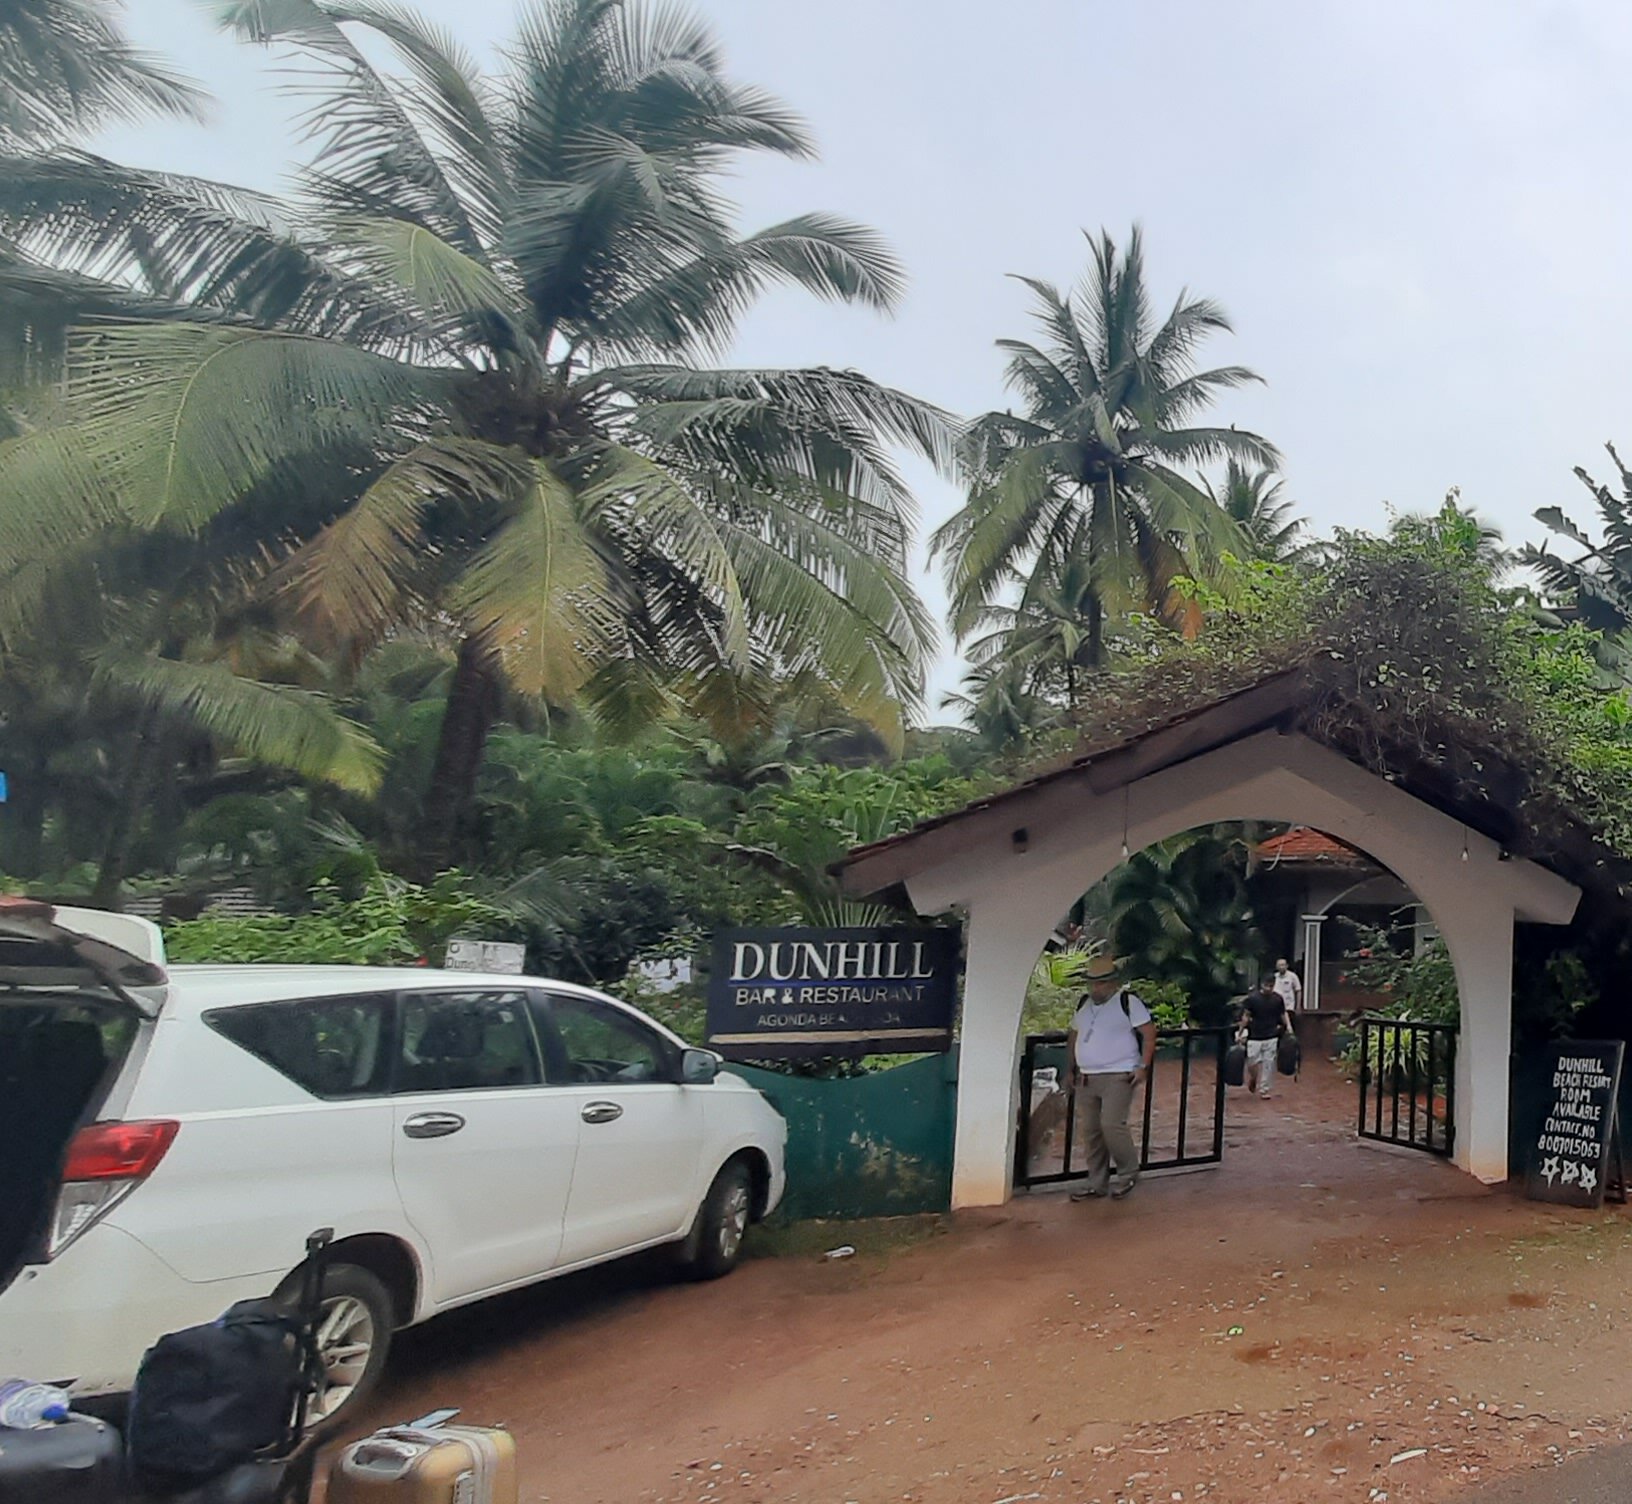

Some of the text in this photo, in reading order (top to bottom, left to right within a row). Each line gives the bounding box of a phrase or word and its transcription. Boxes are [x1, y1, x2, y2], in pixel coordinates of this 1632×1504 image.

[729, 941, 934, 981] DUNHILL
[735, 985, 926, 1006] BAR & RESTAURANT
[757, 1013, 817, 1027] AGONDA
[1558, 1056, 1604, 1074] DUNHILL
[1552, 1071, 1581, 1088] BEACH
[1560, 1087, 1591, 1104] ROOM
[1552, 1101, 1602, 1121] AVAILABLE
